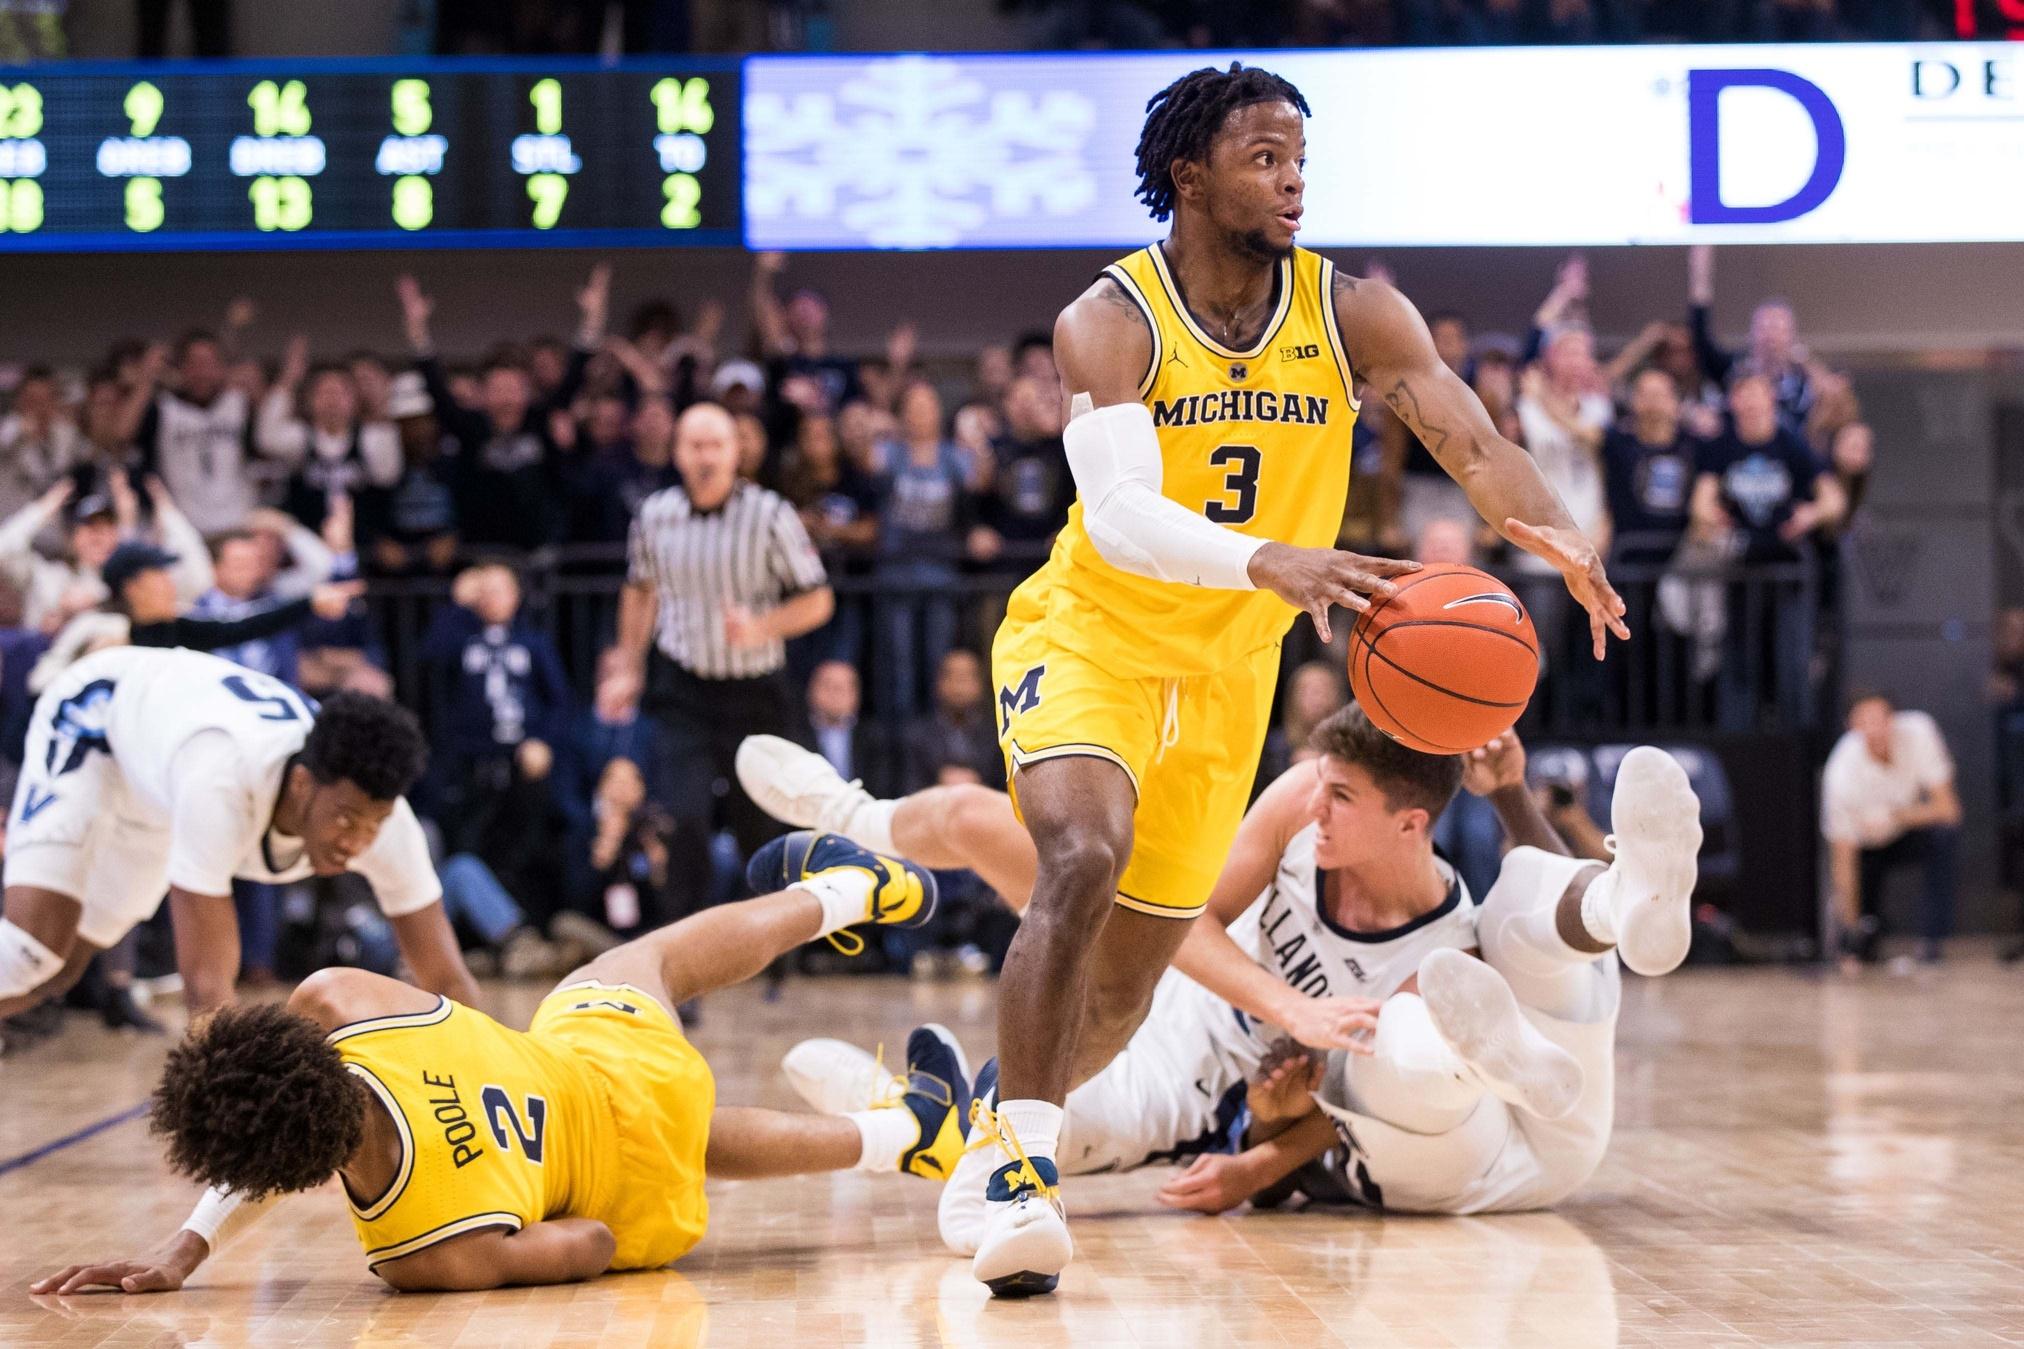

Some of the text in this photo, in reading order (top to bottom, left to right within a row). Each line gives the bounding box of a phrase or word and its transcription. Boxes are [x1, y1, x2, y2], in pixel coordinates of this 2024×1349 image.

[123, 81, 164, 138] 9
[392, 78, 433, 136] 5
[530, 78, 562, 135] 1
[1689, 68, 1845, 224] D
[526, 173, 569, 229] 7
[661, 173, 701, 229] 2
[1153, 390, 1329, 428] MICHIGAN
[1230, 367, 1247, 379] M
[1205, 443, 1262, 524] 3
[1000, 664, 1045, 738] M
[1259, 888, 1333, 999] LLANO
[423, 1070, 484, 1169] POOLE
[481, 1084, 547, 1165] 2
